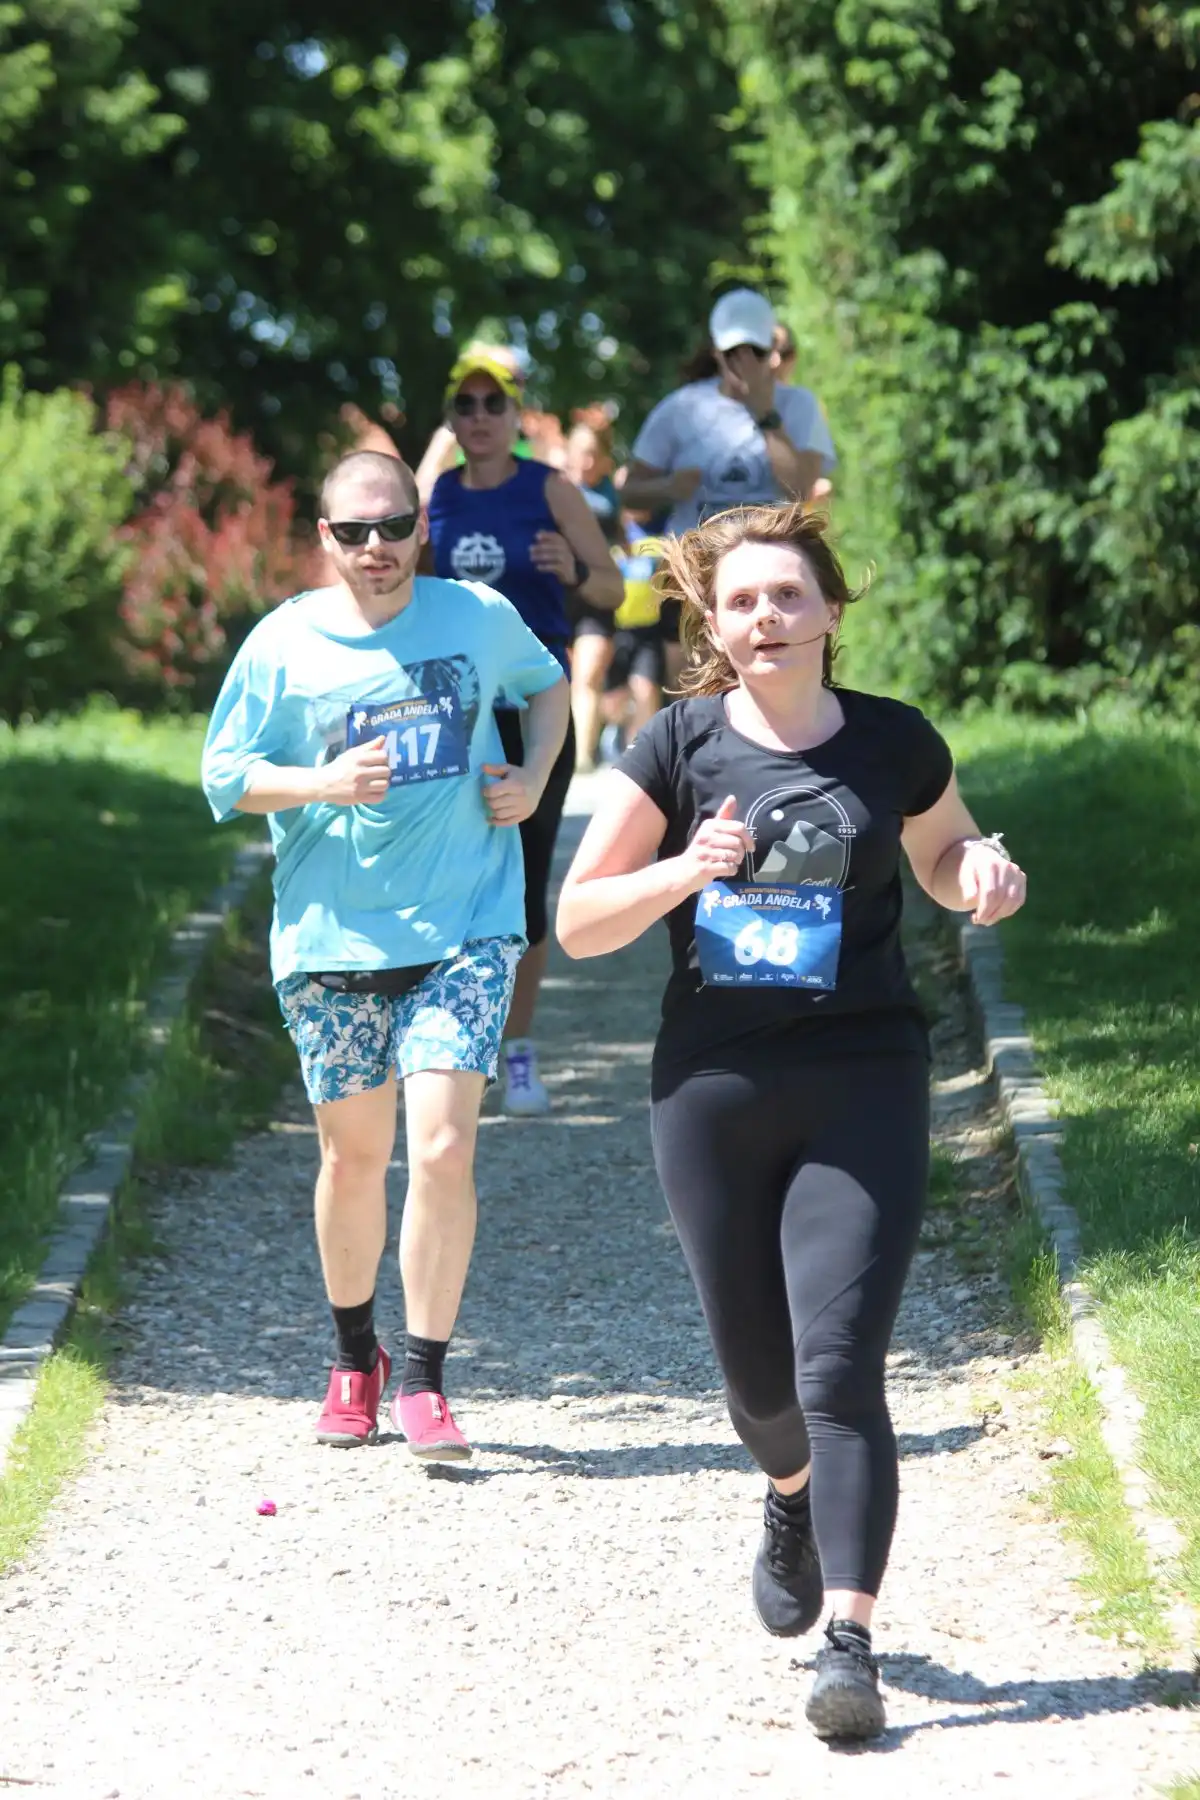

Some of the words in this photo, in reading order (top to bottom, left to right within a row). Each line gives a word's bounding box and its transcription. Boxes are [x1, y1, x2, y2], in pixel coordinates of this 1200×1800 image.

[370, 708, 402, 726] GRADA
[384, 723, 441, 770] 417
[722, 893, 763, 909] GRADA
[734, 919, 799, 966] 68
